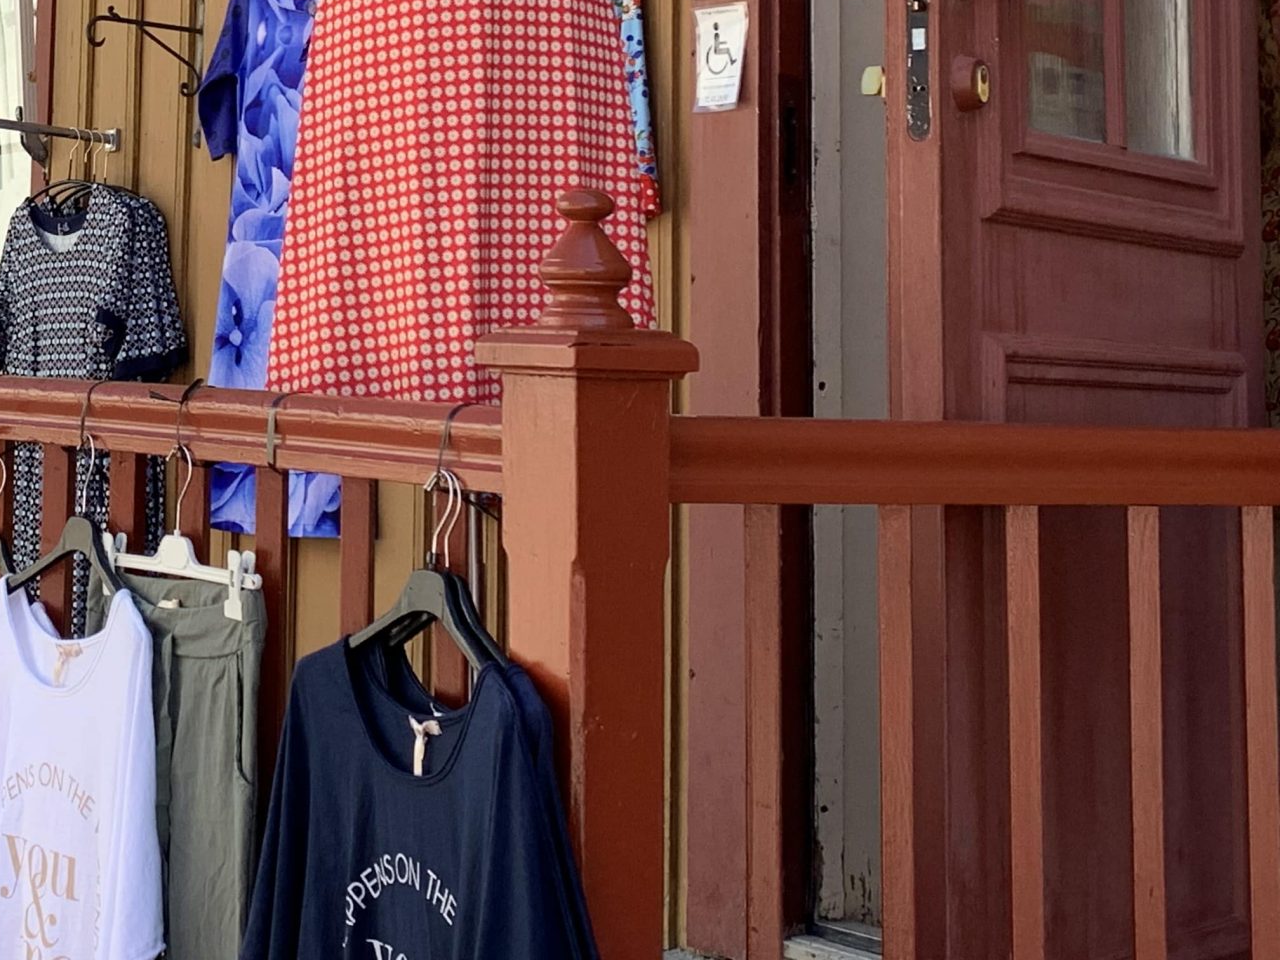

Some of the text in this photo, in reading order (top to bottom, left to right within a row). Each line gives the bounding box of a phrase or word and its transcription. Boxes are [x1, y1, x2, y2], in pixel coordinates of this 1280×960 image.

[39, 762, 64, 792] ON
[66, 775, 96, 821] THE
[0, 833, 80, 900] you
[395, 852, 420, 891] ON
[426, 868, 458, 926] THE
